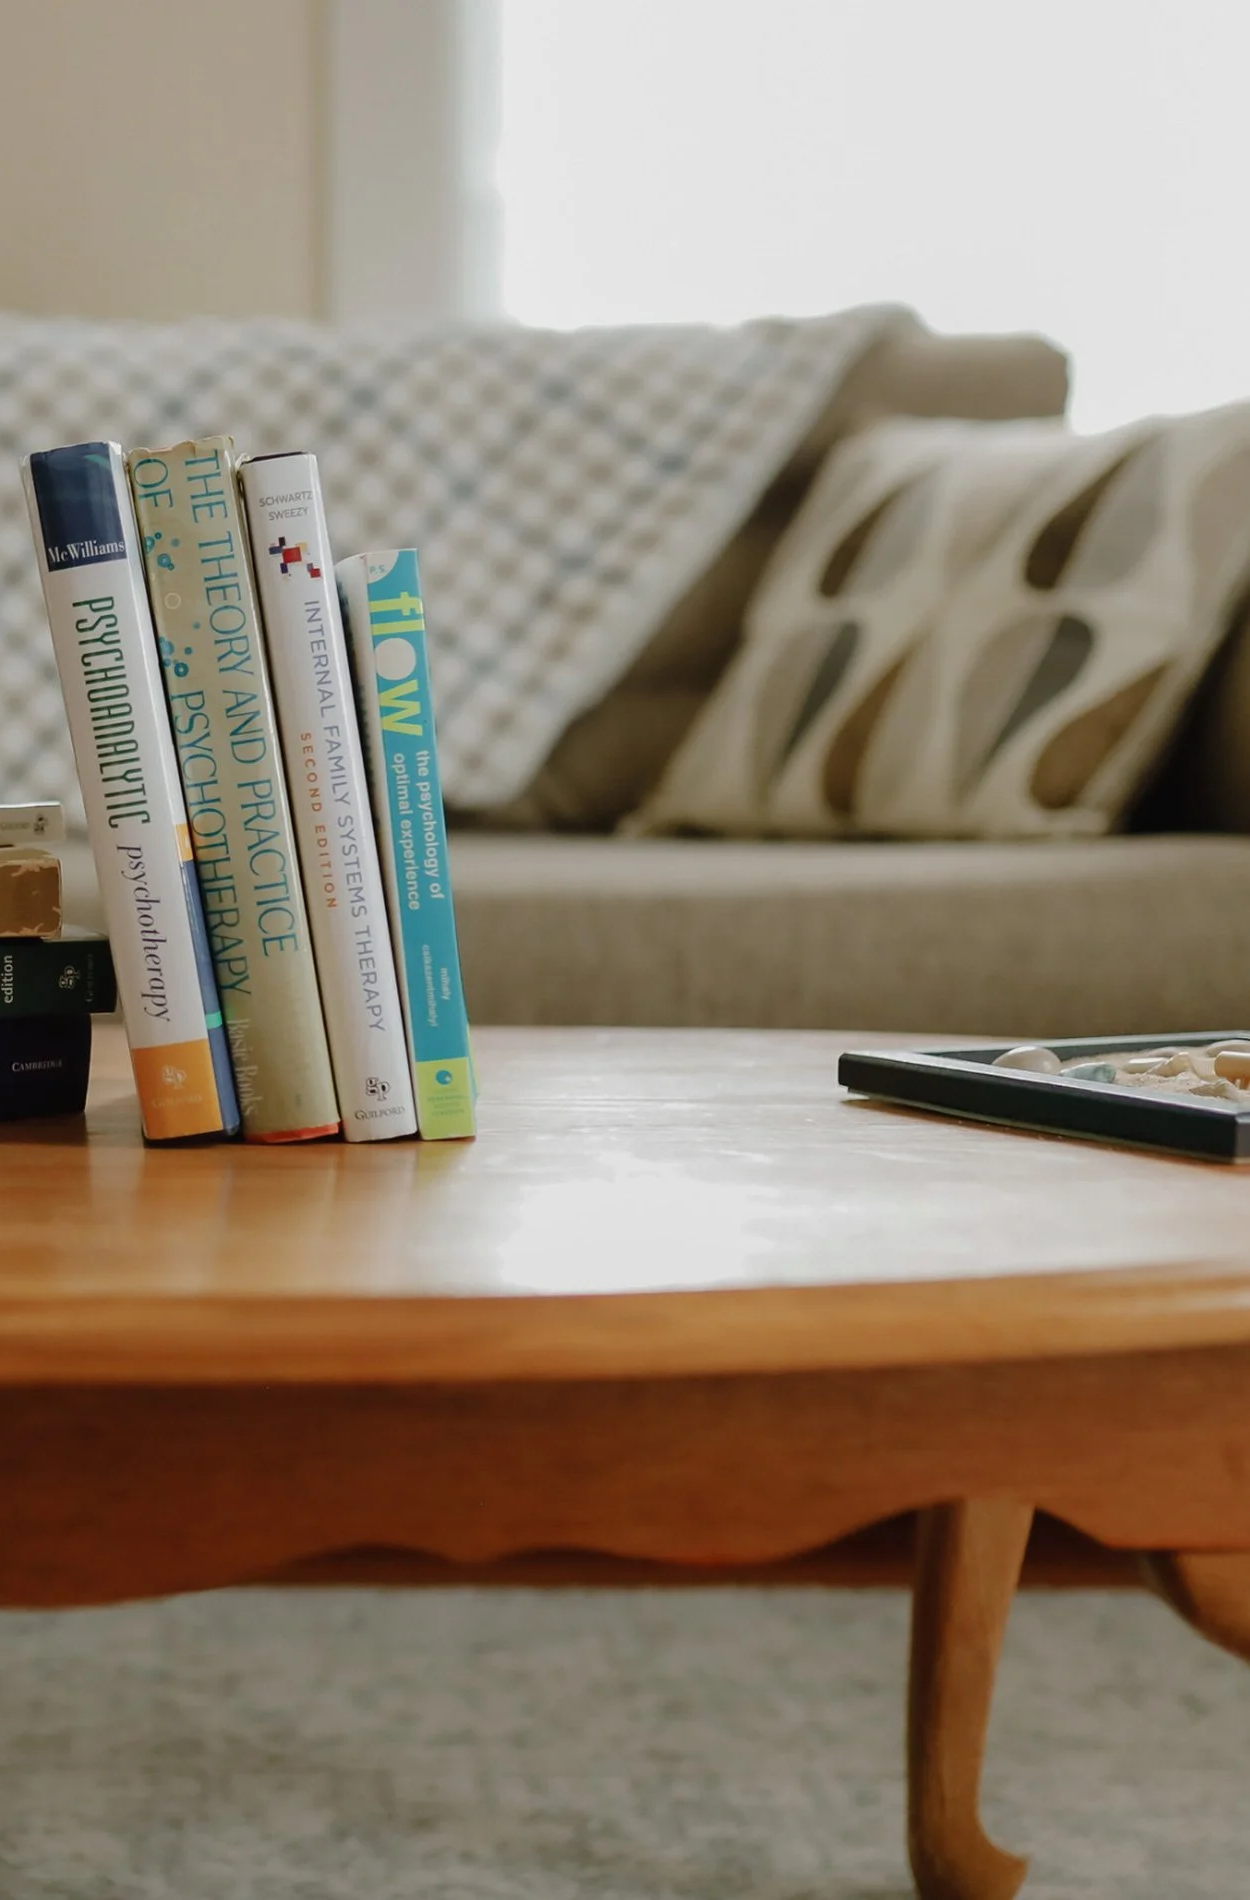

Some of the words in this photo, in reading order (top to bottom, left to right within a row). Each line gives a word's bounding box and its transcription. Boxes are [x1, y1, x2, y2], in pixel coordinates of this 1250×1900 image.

[185, 449, 227, 523] THE
[259, 491, 312, 507] SCHWARTZ
[268, 506, 309, 521] SWEEZY
[48, 540, 125, 563] McWilliams
[198, 531, 254, 676] THEORY
[369, 591, 425, 736] flow
[133, 458, 173, 508] OF
[170, 690, 252, 995] PSYCHOTHERAPY
[222, 689, 267, 764] AND
[392, 753, 413, 814] optimal
[414, 751, 429, 778] the
[72, 596, 151, 828] PSYCHOANALYTIC
[116, 843, 170, 1024] psychotherapy
[300, 733, 322, 812] SECOND
[314, 824, 338, 909] EDITION
[304, 600, 336, 717] INTERNAL
[323, 725, 350, 805] FAMILY
[337, 815, 367, 918] SYSTEMS
[352, 925, 386, 1032] THERAPY
[416, 781, 440, 878] psychology
[237, 778, 298, 957] PRACTICE
[397, 816, 421, 911] experience
[430, 881, 445, 900] of
[1, 954, 14, 1004] edition
[227, 1018, 253, 1061] Basic
[235, 1065, 263, 1116] Books
